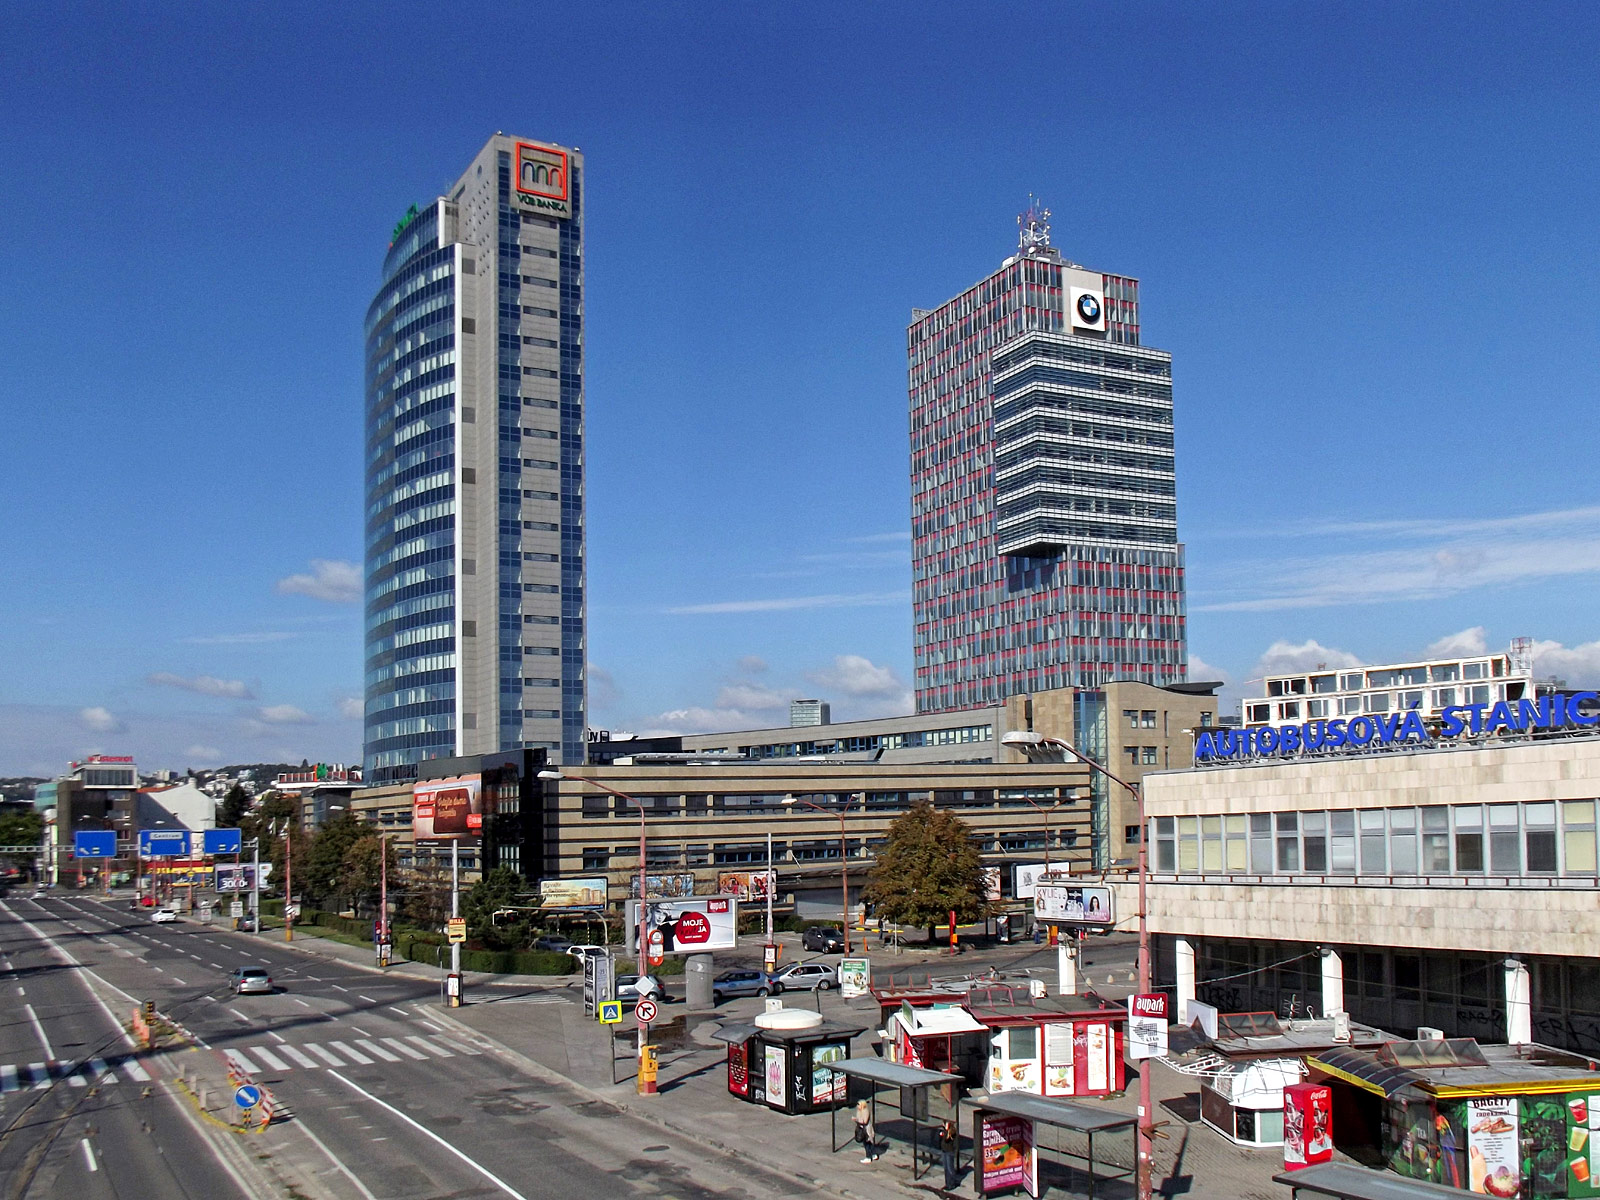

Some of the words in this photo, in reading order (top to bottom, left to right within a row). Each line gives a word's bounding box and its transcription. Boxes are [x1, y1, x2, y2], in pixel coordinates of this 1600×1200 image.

[536, 198, 567, 213] BANKA
[1195, 700, 1430, 758] AUTOBUSOVÁ
[682, 919, 704, 927] MOJE
[1136, 997, 1165, 1013] aupark
